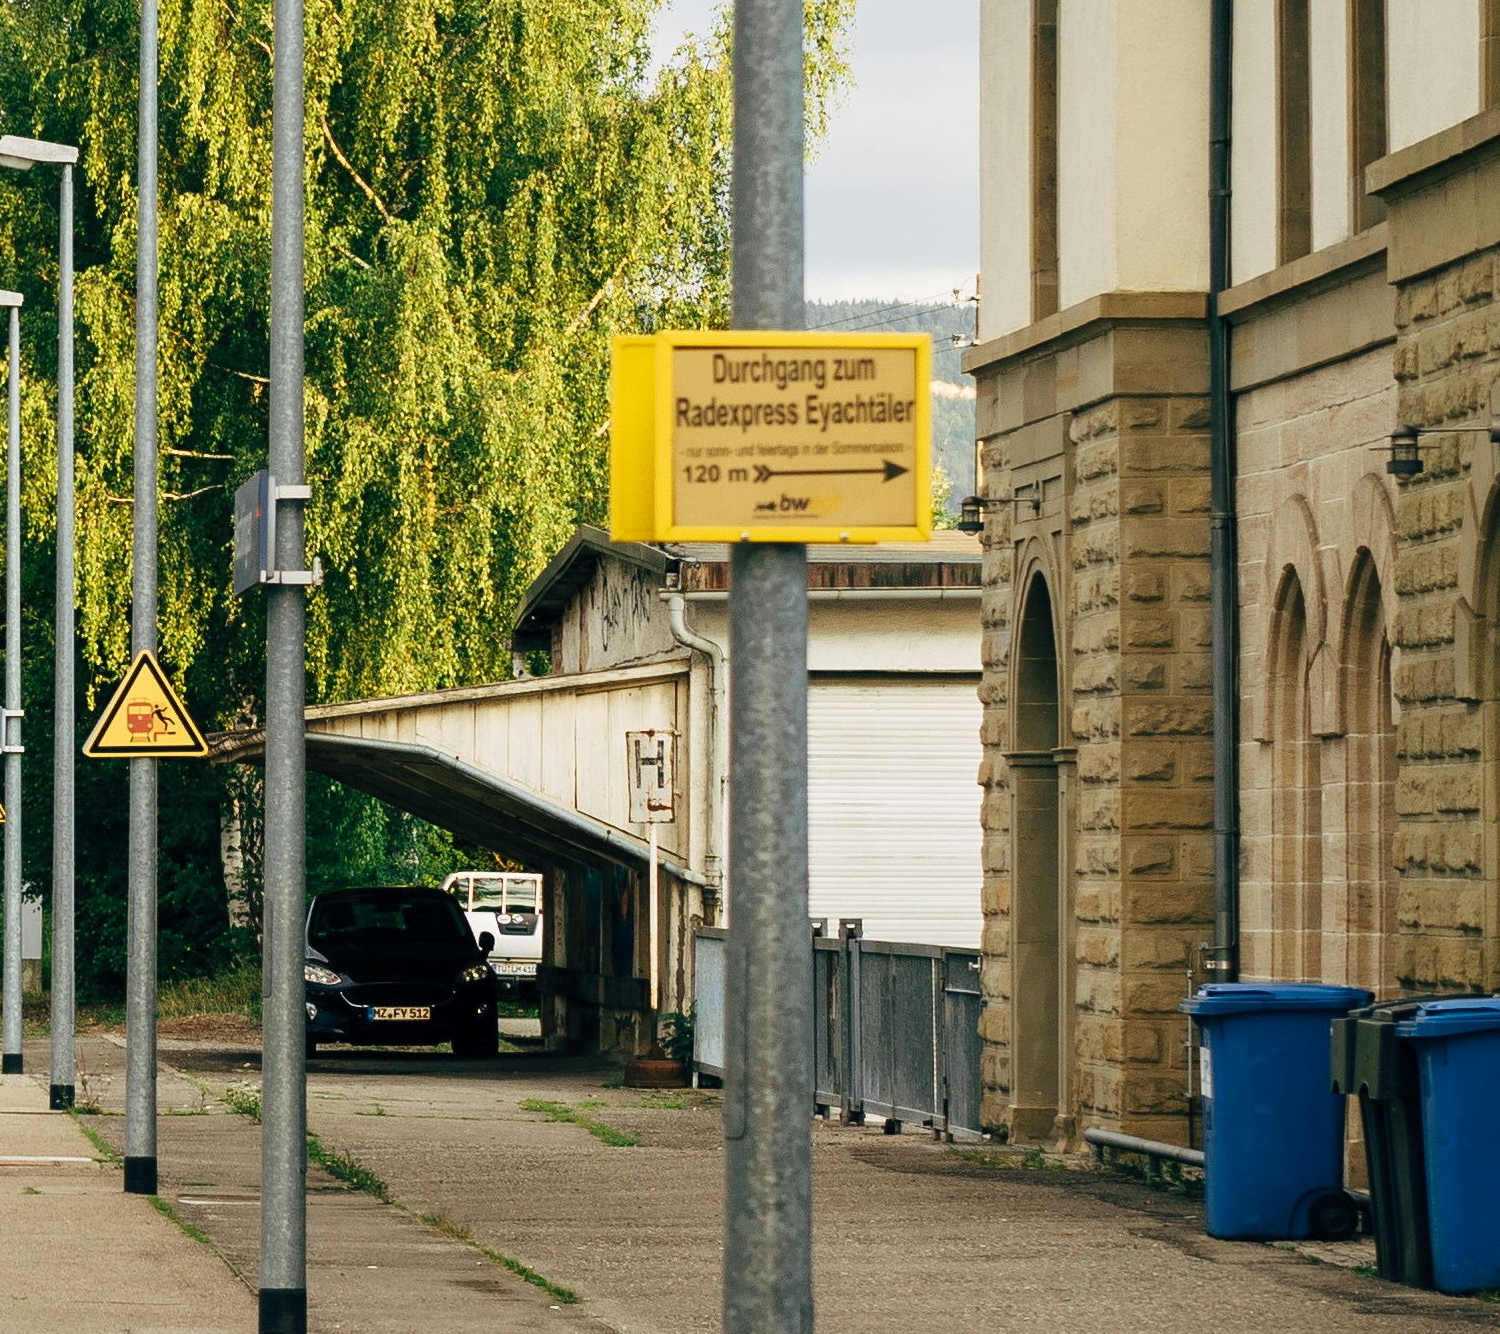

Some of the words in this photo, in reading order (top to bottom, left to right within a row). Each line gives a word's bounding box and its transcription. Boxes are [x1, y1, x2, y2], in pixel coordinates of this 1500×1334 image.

[713, 353, 826, 390] Durchgang
[832, 358, 876, 382] zum
[675, 397, 798, 434] Radexpress
[805, 392, 915, 433] Eyachtäler
[736, 444, 754, 456] und
[813, 442, 829, 455] der
[682, 464, 721, 483] 120
[727, 468, 748, 483] m
[634, 739, 665, 789] H
[373, 1008, 388, 1018] MZ
[393, 1008, 408, 1018] FY
[409, 1008, 430, 1019] 512
